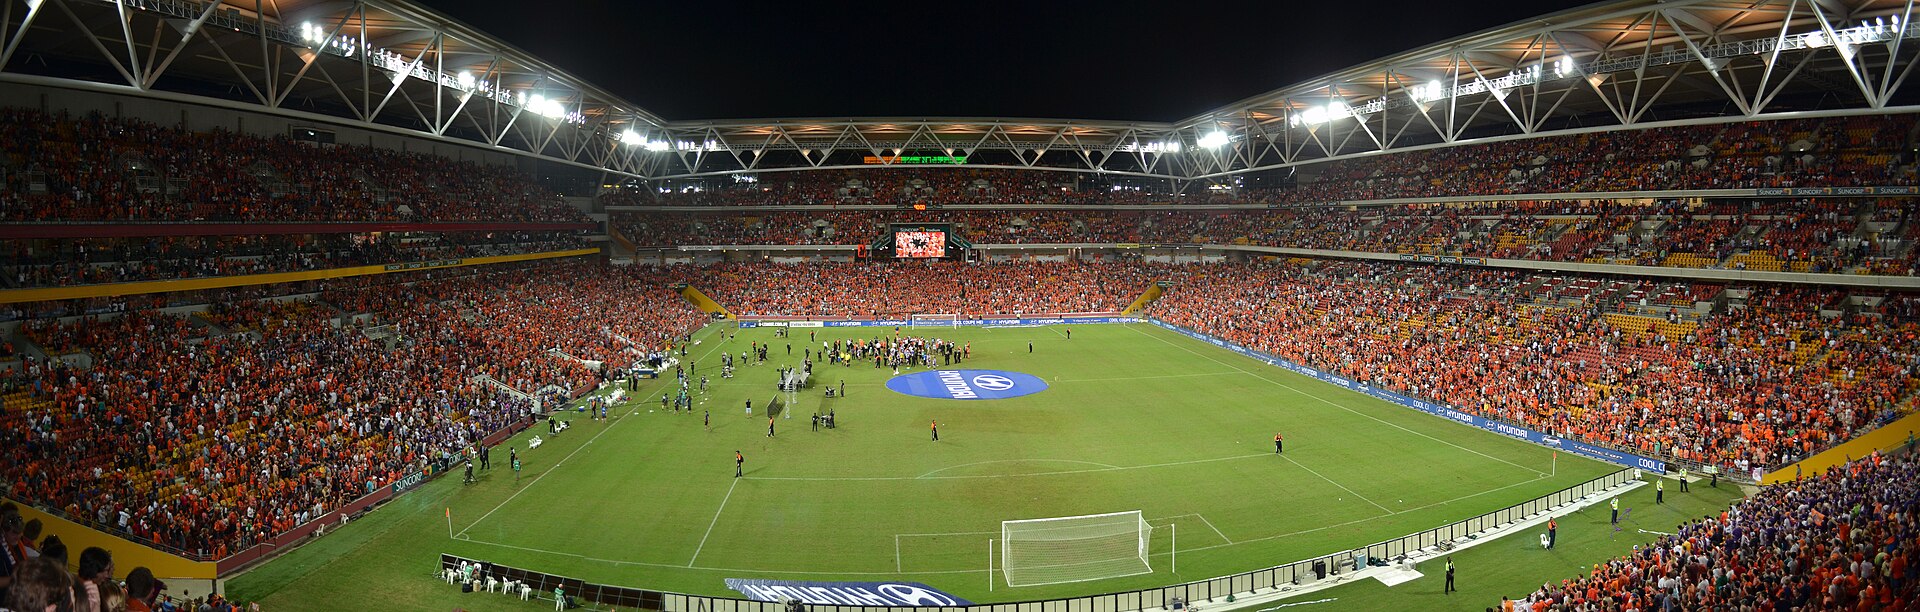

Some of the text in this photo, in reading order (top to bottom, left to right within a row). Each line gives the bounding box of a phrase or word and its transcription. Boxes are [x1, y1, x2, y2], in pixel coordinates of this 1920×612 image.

[938, 370, 978, 398] HYUNDAI
[1446, 409, 1473, 424] HYUNDAI
[1497, 423, 1528, 438] HYUNDAI
[1638, 458, 1657, 471] COOL
[395, 471, 423, 492] SUNCORP
